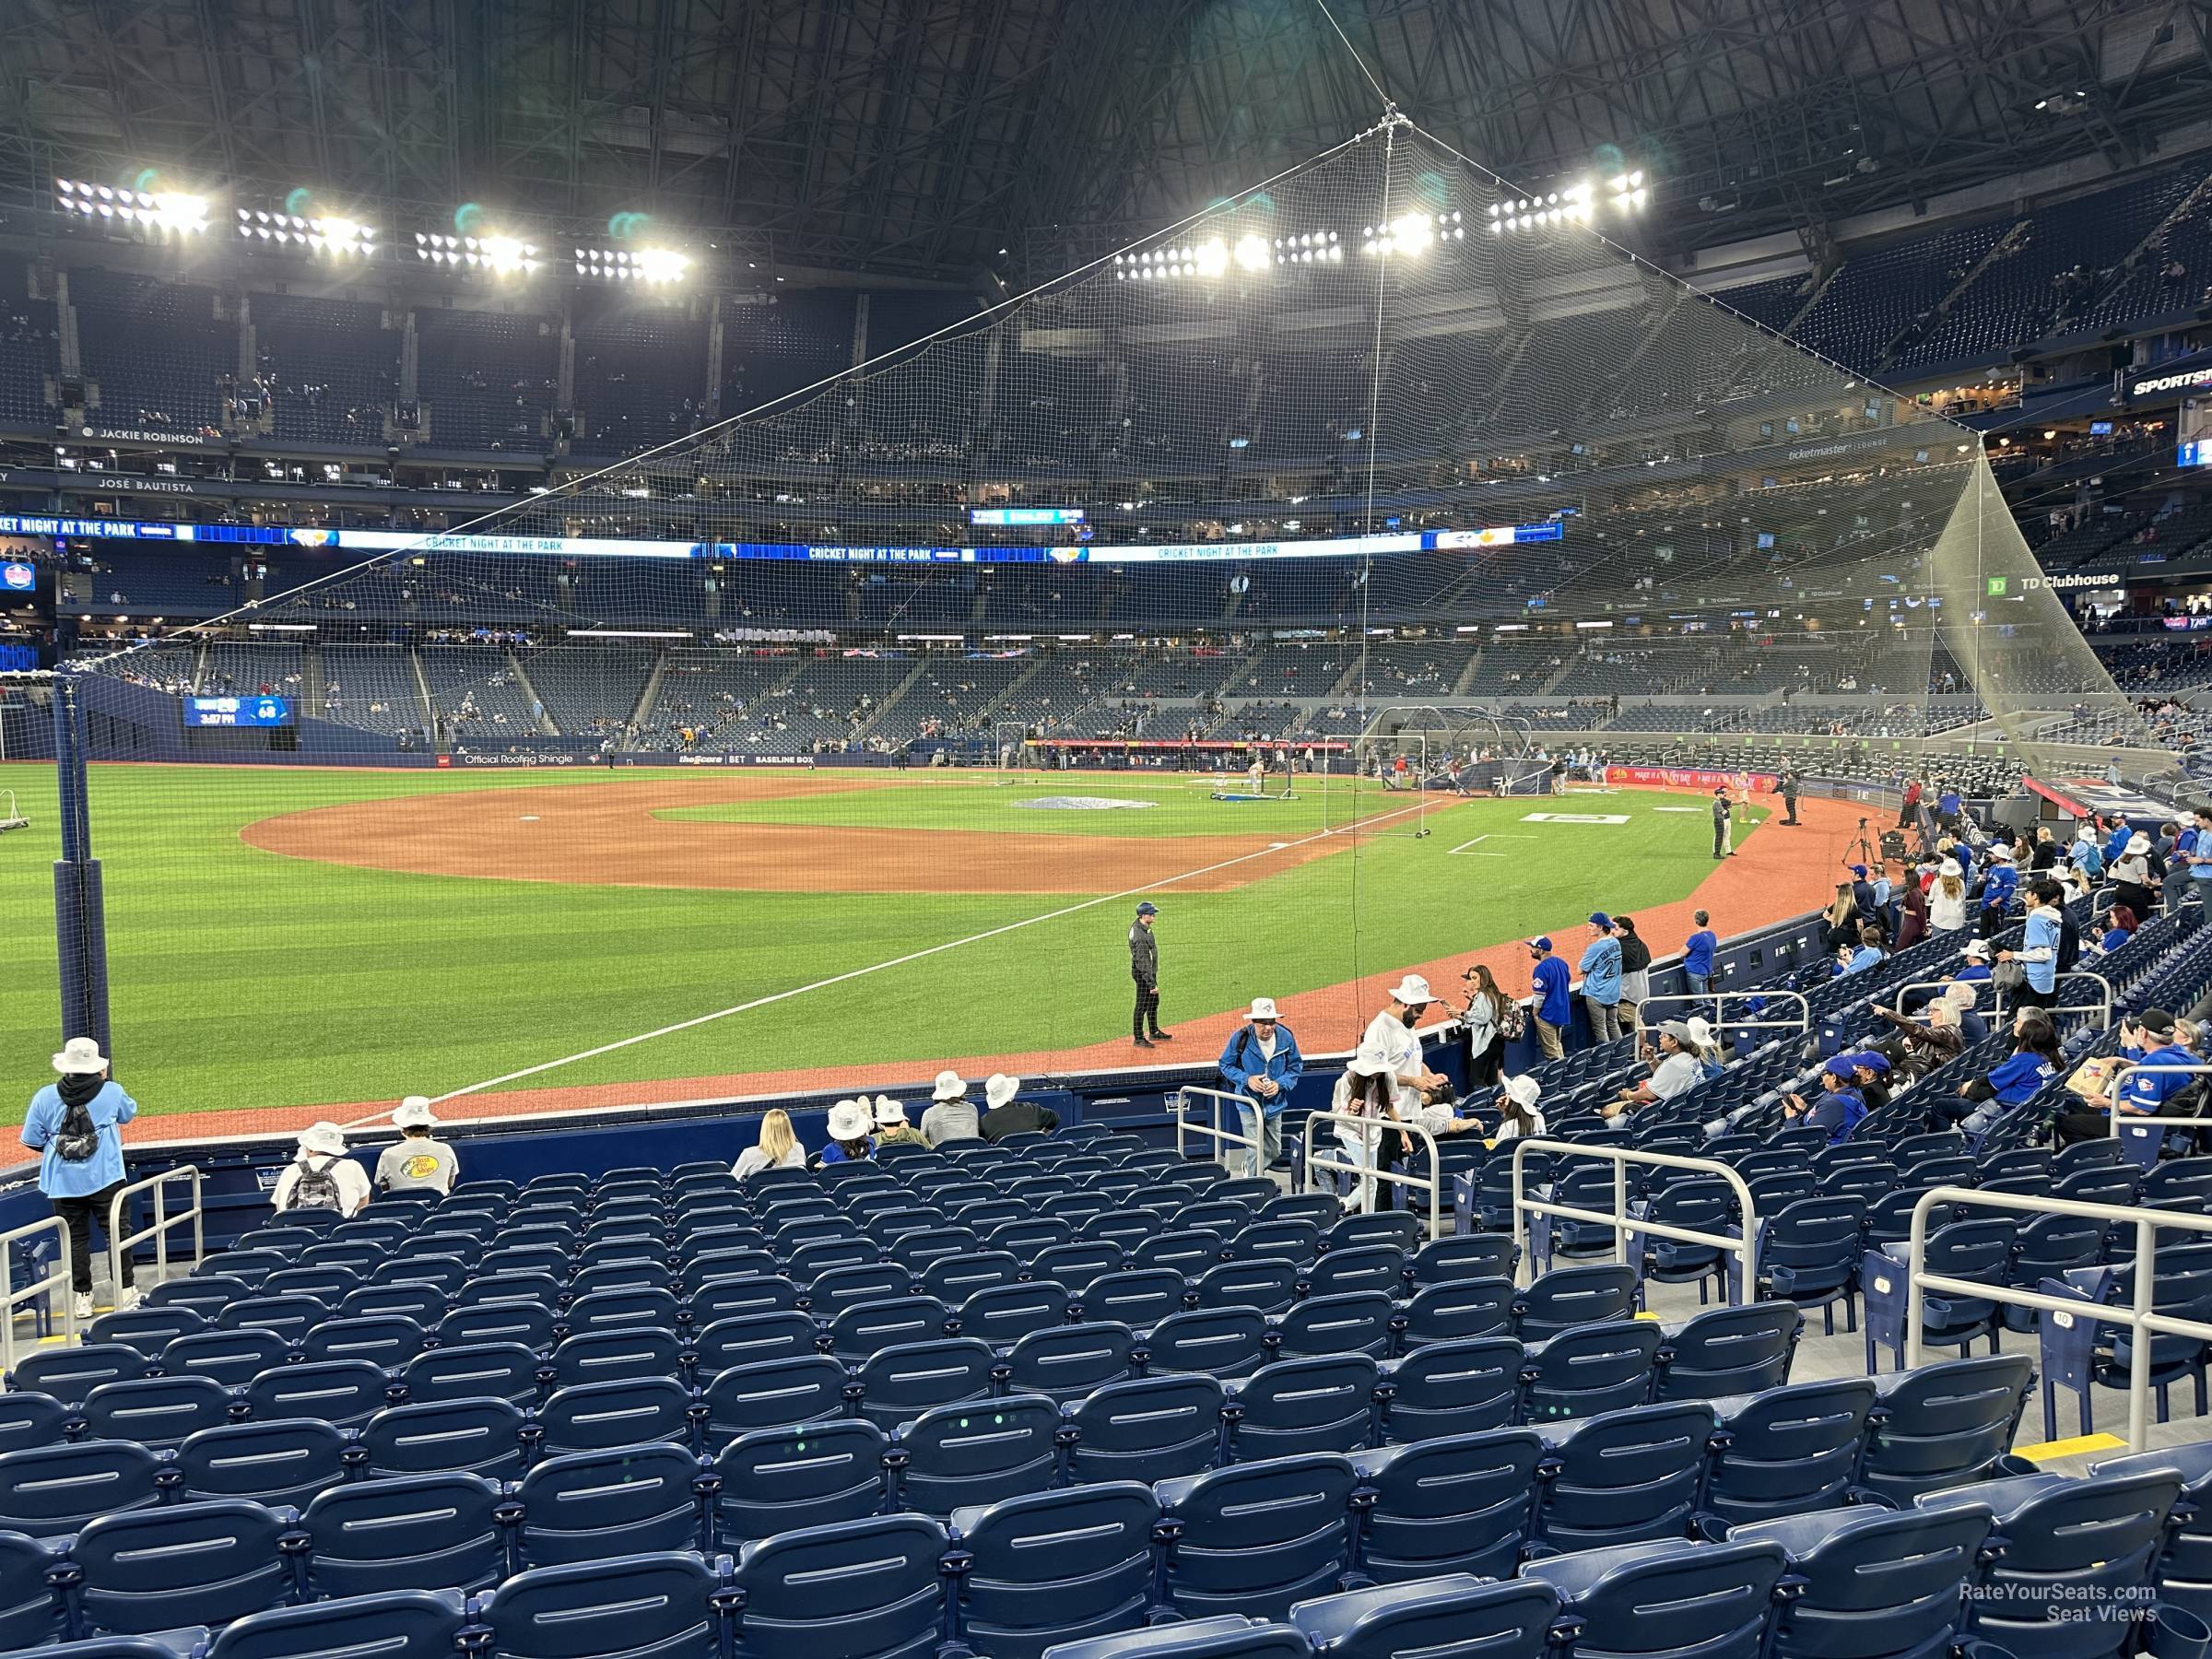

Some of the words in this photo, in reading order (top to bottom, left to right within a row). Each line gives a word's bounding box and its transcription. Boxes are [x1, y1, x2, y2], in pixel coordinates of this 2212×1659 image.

[100, 429, 140, 440] JACKIE
[144, 432, 204, 444] ROBINSON
[1788, 444, 1847, 460] ticketmaster
[99, 478, 130, 488] JOSÉ
[136, 480, 194, 492] BAUTISTA
[22, 519, 59, 534] NIGHT
[61, 521, 76, 534] AT
[77, 521, 101, 535] THE
[103, 522, 135, 536] PARK
[426, 537, 466, 547] CRICKET
[471, 539, 500, 548] NIGHT
[503, 540, 513, 549] AT
[517, 540, 534, 549] THE
[538, 541, 562, 550] PARK
[808, 547, 847, 559] CRICKET
[848, 547, 877, 559] NIGHT
[877, 548, 888, 559] AT
[889, 548, 906, 560] THE
[908, 550, 931, 560] PARK
[1159, 547, 1194, 559] CRICKET
[1197, 547, 1222, 557] NIGHT
[1225, 547, 1235, 557] AT
[1238, 546, 1253, 556] THE
[1256, 545, 1278, 555] PARK
[2021, 578, 2040, 590] TD
[2041, 573, 2119, 588] Clubhouse
[222, 714, 236, 724] PM
[465, 755, 499, 764] Official
[500, 755, 536, 767] Roofing
[538, 754, 573, 765] Shingle
[678, 756, 723, 764] theScore
[729, 756, 746, 764] BET
[756, 756, 795, 764] BASELINE
[796, 756, 814, 764] BOX
[1634, 771, 1650, 781] MAKE
[2058, 1313, 2068, 1324] 10
